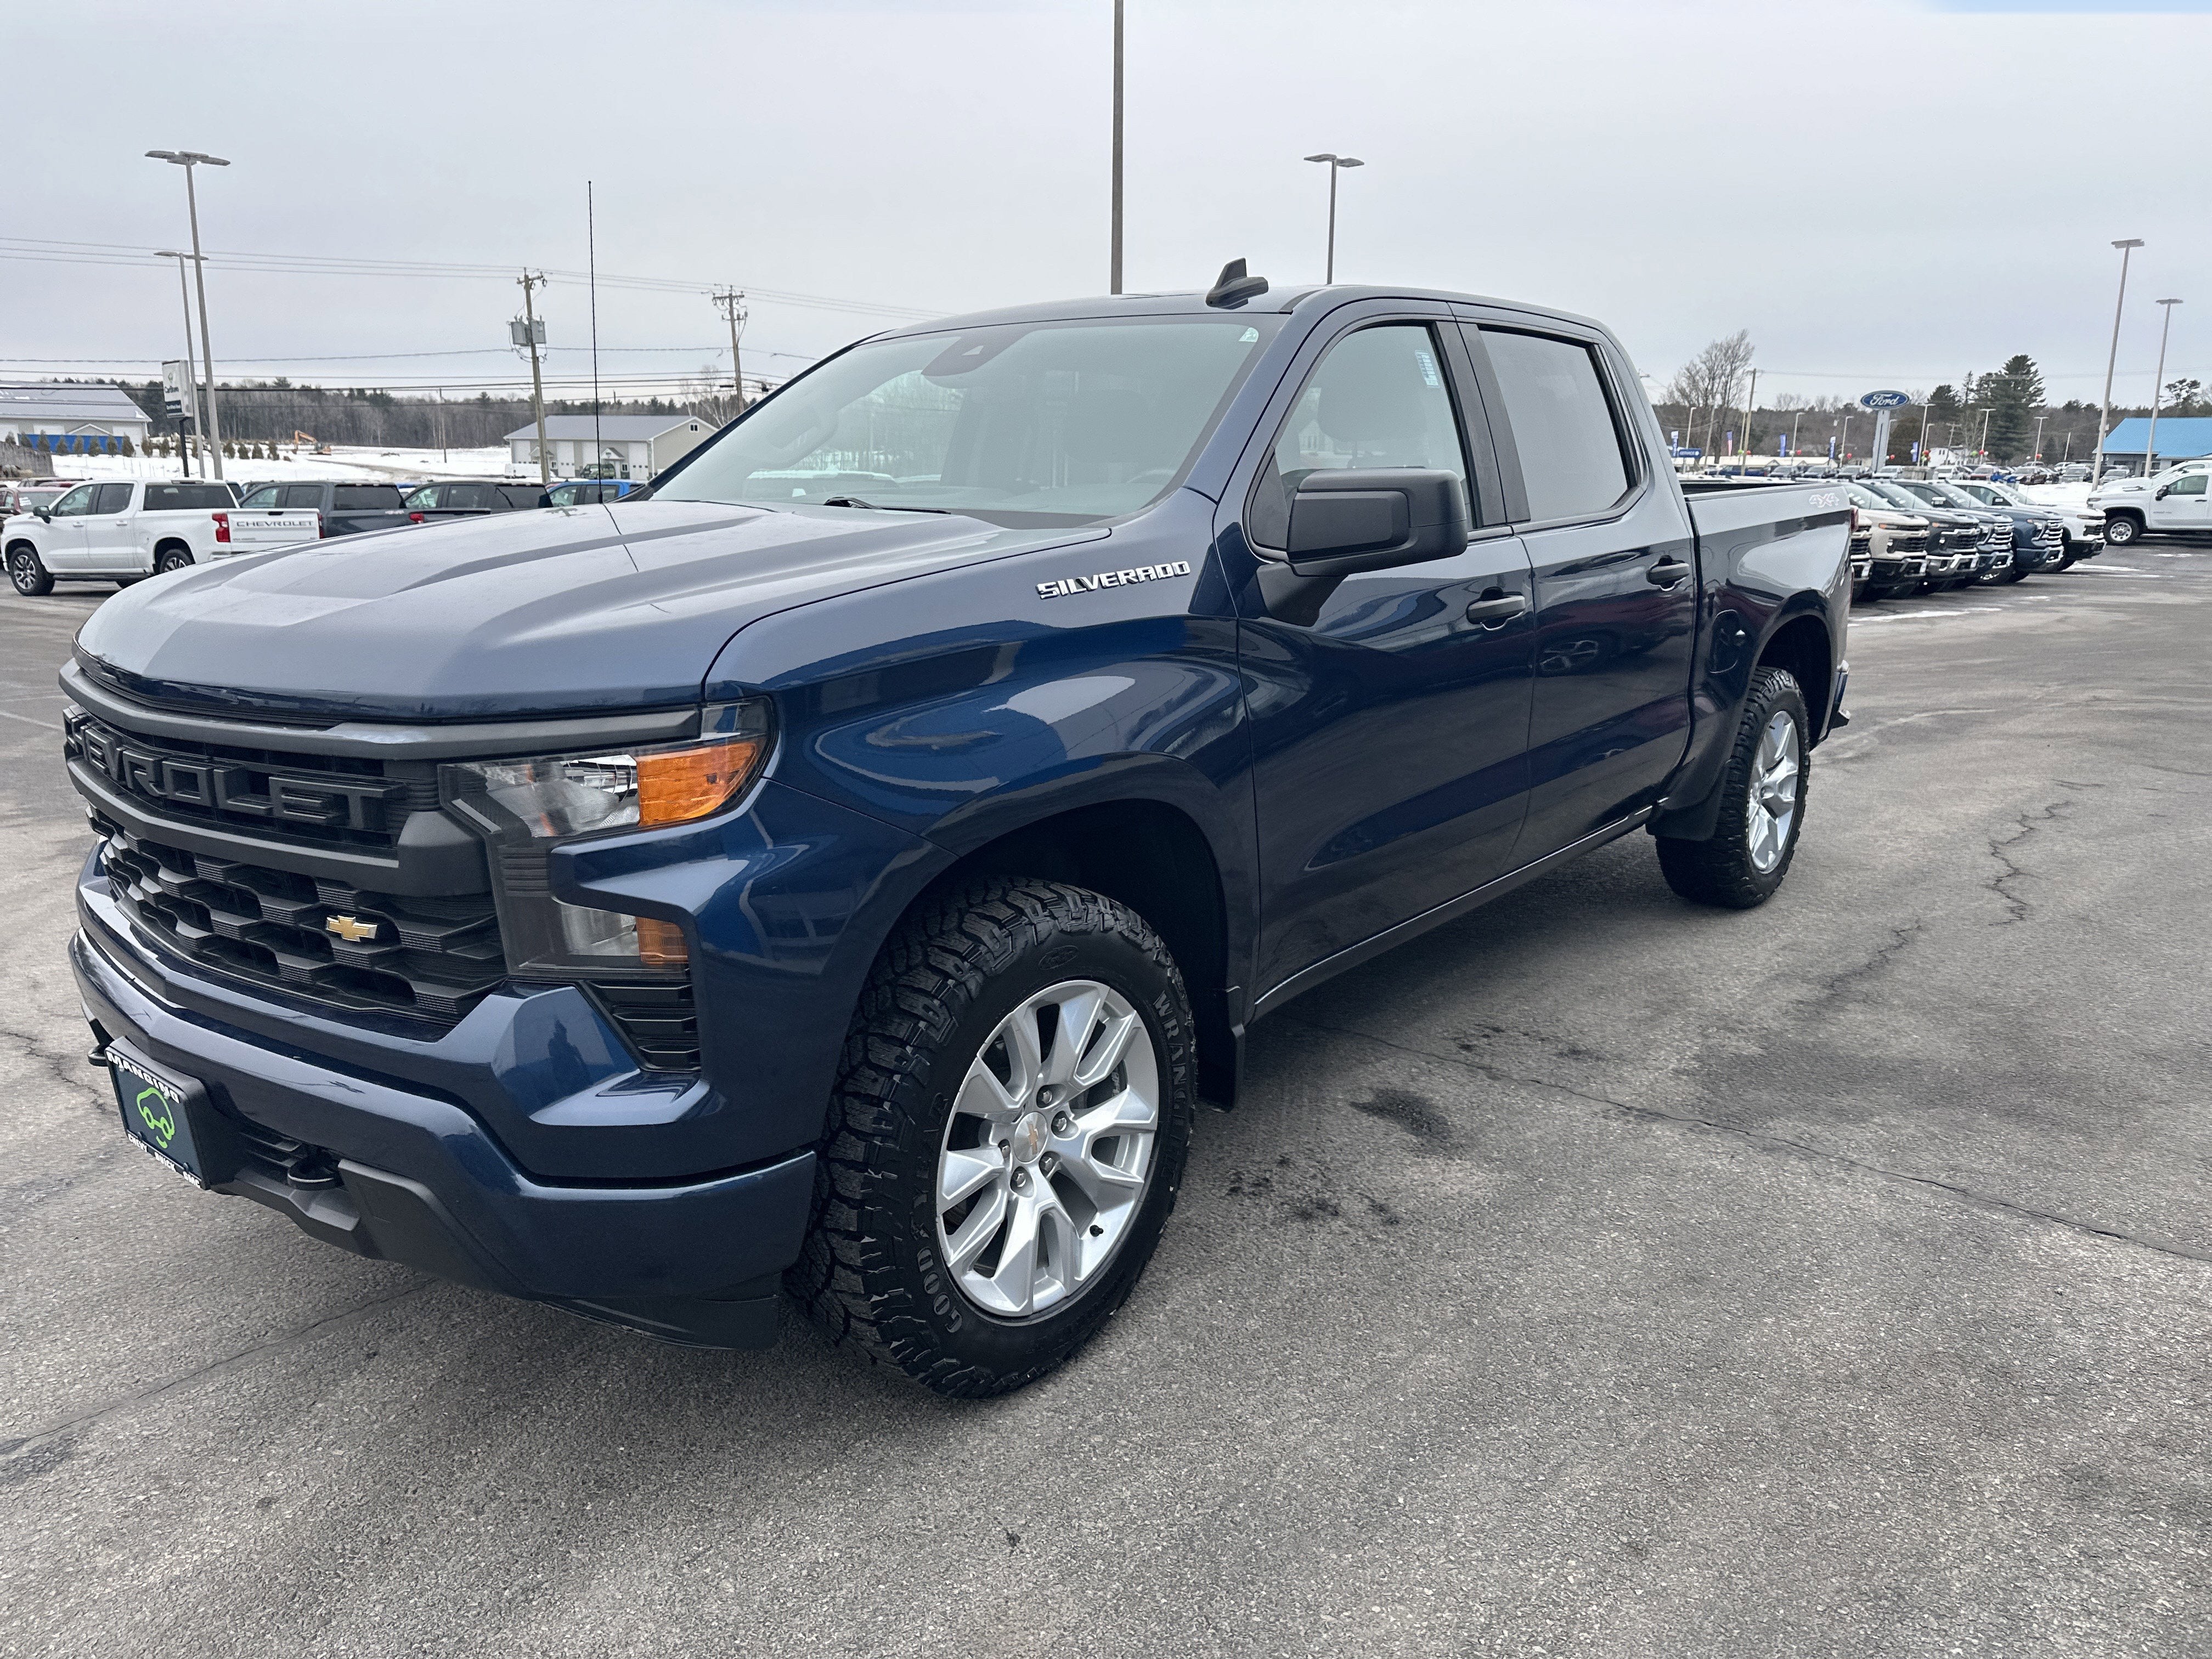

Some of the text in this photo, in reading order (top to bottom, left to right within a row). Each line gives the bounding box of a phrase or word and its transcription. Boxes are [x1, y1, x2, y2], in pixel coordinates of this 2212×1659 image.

[1869, 393, 1900, 405] Ford
[1036, 561, 1191, 600] SILVERADO
[106, 1051, 180, 1104] MANGINO
[127, 1133, 201, 1189] CHEVY BUICK GMC
[910, 1092, 963, 1334] GOODYER
